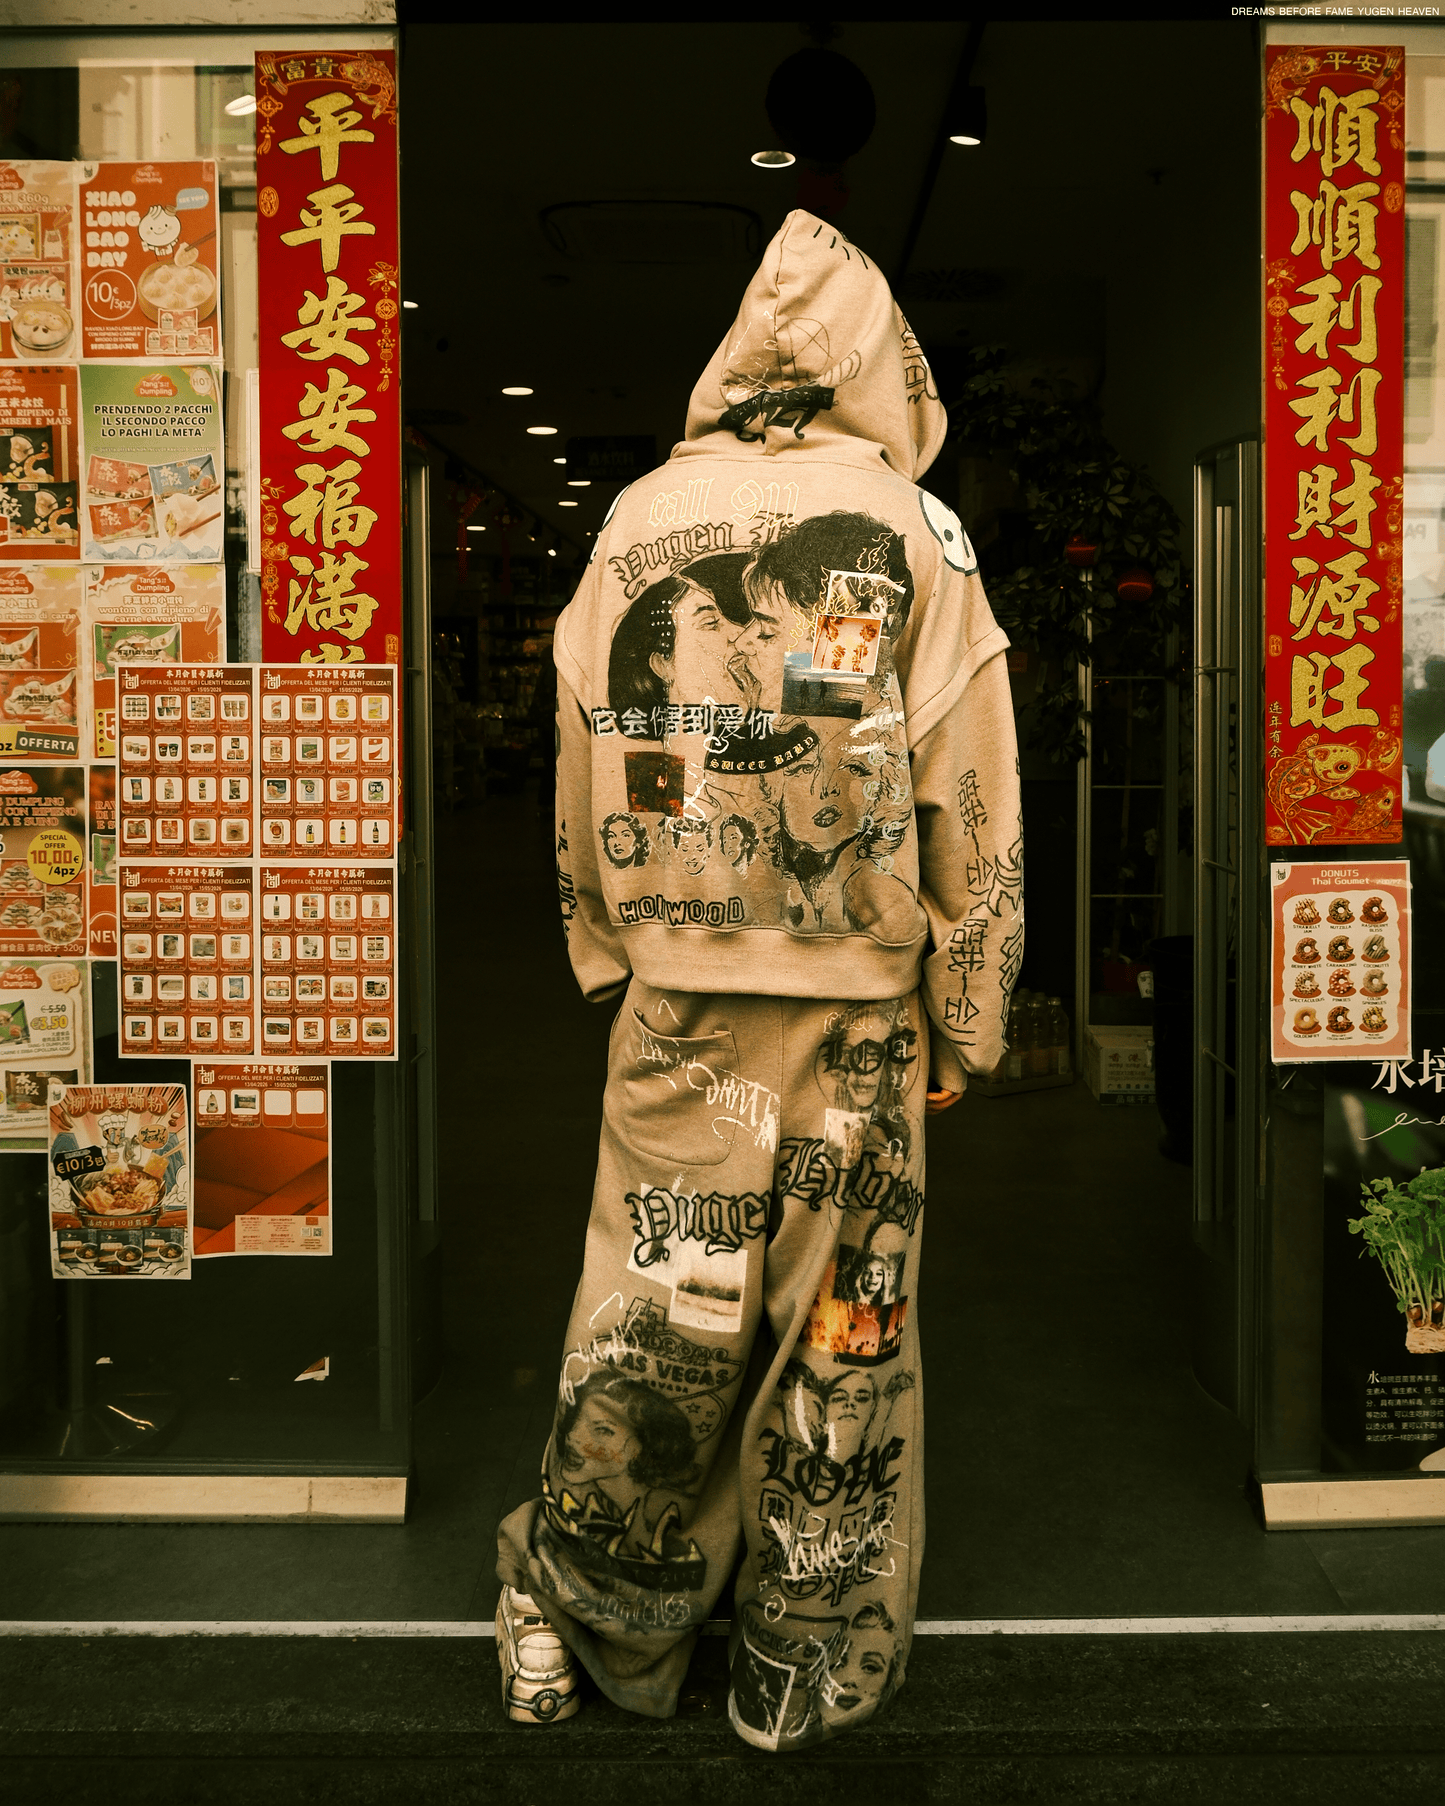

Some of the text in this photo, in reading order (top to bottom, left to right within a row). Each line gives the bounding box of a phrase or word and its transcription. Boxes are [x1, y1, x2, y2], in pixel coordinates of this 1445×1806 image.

[1323, 51, 1382, 74] 平安
[85, 190, 137, 207] XIAO
[85, 210, 141, 227] LONG
[86, 230, 130, 247] BAO
[86, 251, 128, 268] DAY
[140, 387, 173, 396] Dumpling
[94, 405, 212, 414] PRENDENDO 2 PACCHI
[46, 417, 72, 425] MAIS
[102, 417, 206, 426] IL SECONDO PACCO
[101, 428, 205, 437] LO PAGHI LA META'
[647, 477, 801, 529] call 911
[608, 522, 733, 600] Yugen
[137, 584, 170, 593] Dumpling
[98, 606, 136, 614] wonton
[161, 606, 196, 616] ripieno
[200, 605, 209, 614] di
[39, 611, 48, 619] di
[51, 612, 76, 620] carne
[155, 615, 193, 623] verdure
[19, 736, 75, 752] OFFERTA
[709, 736, 816, 771] SWEET BABY
[5, 797, 65, 806] DUMPLING
[4, 807, 78, 816] CON RIPIENO
[24, 817, 59, 826] SUINO
[30, 850, 72, 866] 10.00
[48, 866, 75, 877] /4pz
[1320, 869, 1360, 878] DONUTS
[1311, 877, 1331, 885] Thai
[3, 980, 37, 989] Dumpling
[656, 1359, 729, 1386] VEGAS
